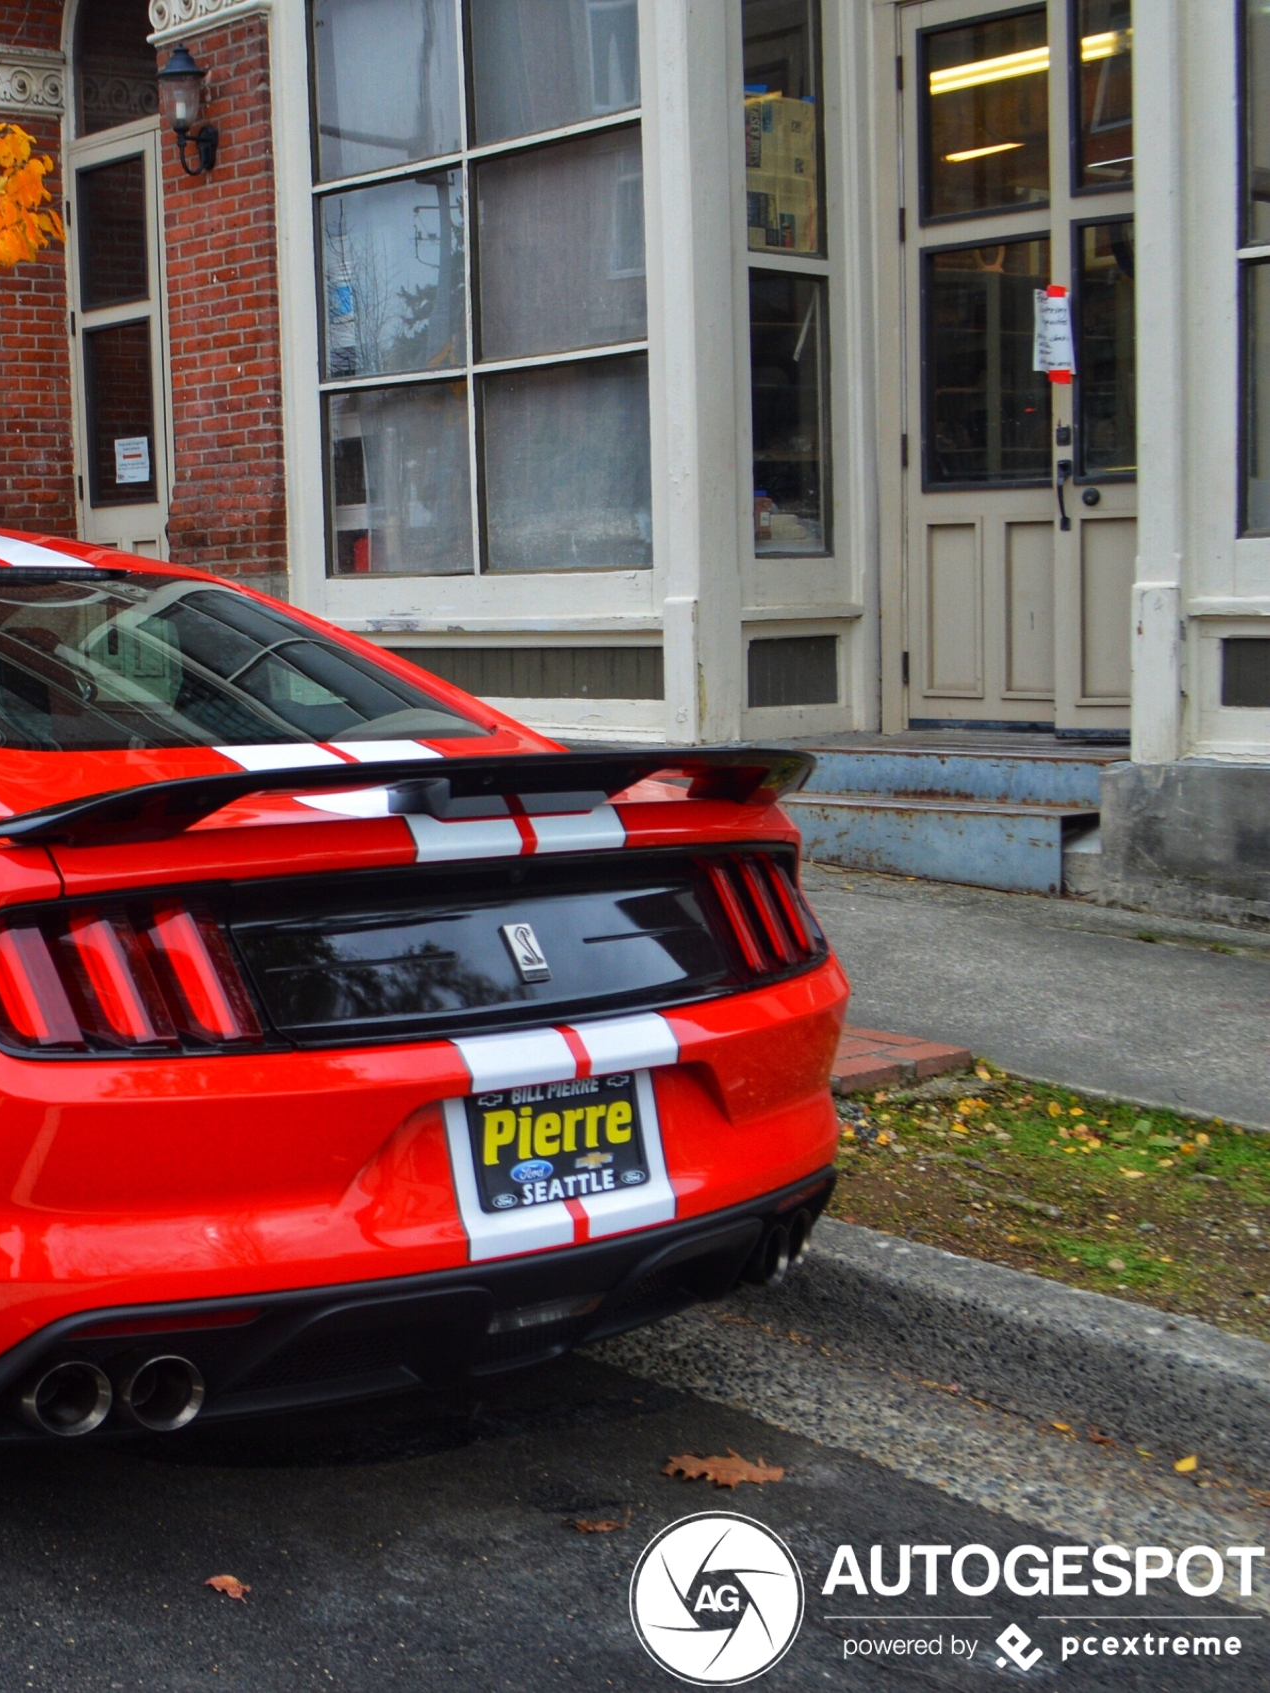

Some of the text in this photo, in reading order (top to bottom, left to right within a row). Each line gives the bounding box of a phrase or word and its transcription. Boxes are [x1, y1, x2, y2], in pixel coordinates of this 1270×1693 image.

[511, 1078, 599, 1104] BILL PIERRE
[483, 1101, 632, 1166] Pierre
[519, 1164, 546, 1180] Ford
[522, 1169, 616, 1206] SEATTLE
